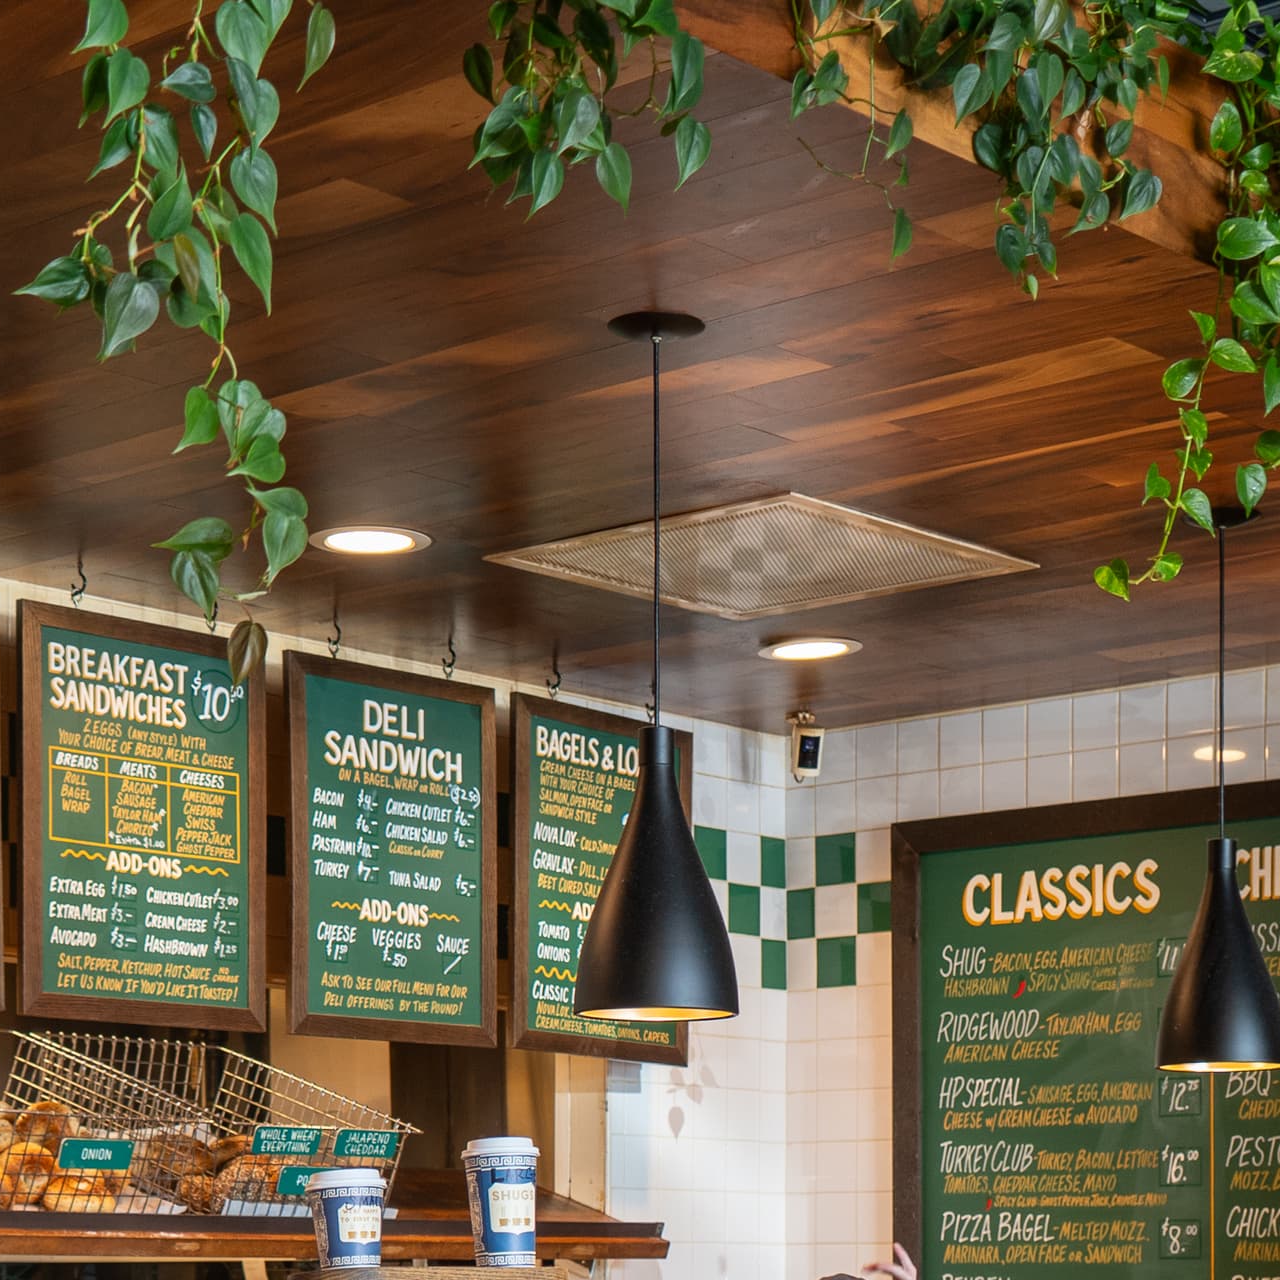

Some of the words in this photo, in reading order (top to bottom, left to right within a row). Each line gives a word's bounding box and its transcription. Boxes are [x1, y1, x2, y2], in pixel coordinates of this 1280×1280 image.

[47, 641, 189, 695] BREAKFAST
[49, 677, 187, 729] SANDWICHES
[363, 698, 425, 741] DELI
[324, 730, 463, 784] SANDWICH
[536, 725, 599, 769] BAGELS
[601, 744, 614, 770] &
[55, 751, 100, 771] BREADS
[120, 762, 158, 780] MEATS
[179, 769, 224, 789] CHEESES
[61, 783, 92, 802] BAGEL
[115, 791, 157, 809] SAUSAGE
[181, 789, 225, 807] AMERICAN
[313, 787, 344, 808] BACON
[312, 812, 337, 830] HAM
[312, 834, 355, 856] PASTRAMI
[105, 851, 183, 879] ADD-ONS
[314, 859, 349, 880] TURKEY
[49, 876, 85, 896] EXTRA
[86, 878, 106, 898] EGG
[388, 869, 411, 888] TUNA
[412, 872, 441, 892] SALAD
[961, 858, 1162, 927] CLASSICS
[359, 898, 429, 927] ADD-ONS
[50, 926, 97, 948] AVOCADO
[316, 920, 357, 944] CHEESE
[372, 928, 422, 950] VEGGIES
[436, 934, 470, 955] SAUCE
[538, 921, 570, 941] TOMATO
[144, 934, 208, 958] HASHBROWN
[537, 943, 570, 962] ONIONS
[939, 944, 986, 978] SHUG
[532, 980, 569, 1003] CLASSIC
[323, 994, 343, 1008] DELI
[346, 995, 394, 1012] OFFERINGS
[399, 999, 411, 1012] BY
[412, 1000, 429, 1014] THE
[430, 1000, 463, 1016] POUND!
[937, 1009, 1040, 1043] RIDGEWOOD
[944, 1043, 1007, 1064] AMERICAN
[1011, 1039, 1059, 1059] CHEESE
[939, 1077, 965, 1110] HP
[962, 1077, 1023, 1108] SPECIAL
[1224, 1070, 1271, 1099] BBQ
[81, 1149, 113, 1161] ONION
[261, 1140, 311, 1153] EVERYTHING
[344, 1143, 387, 1156] CHEDDAR
[940, 1140, 993, 1173] TURKEY
[989, 1141, 1034, 1173] CLUB
[940, 1211, 992, 1243] PIZZA
[998, 1211, 1054, 1242] BAGEL
